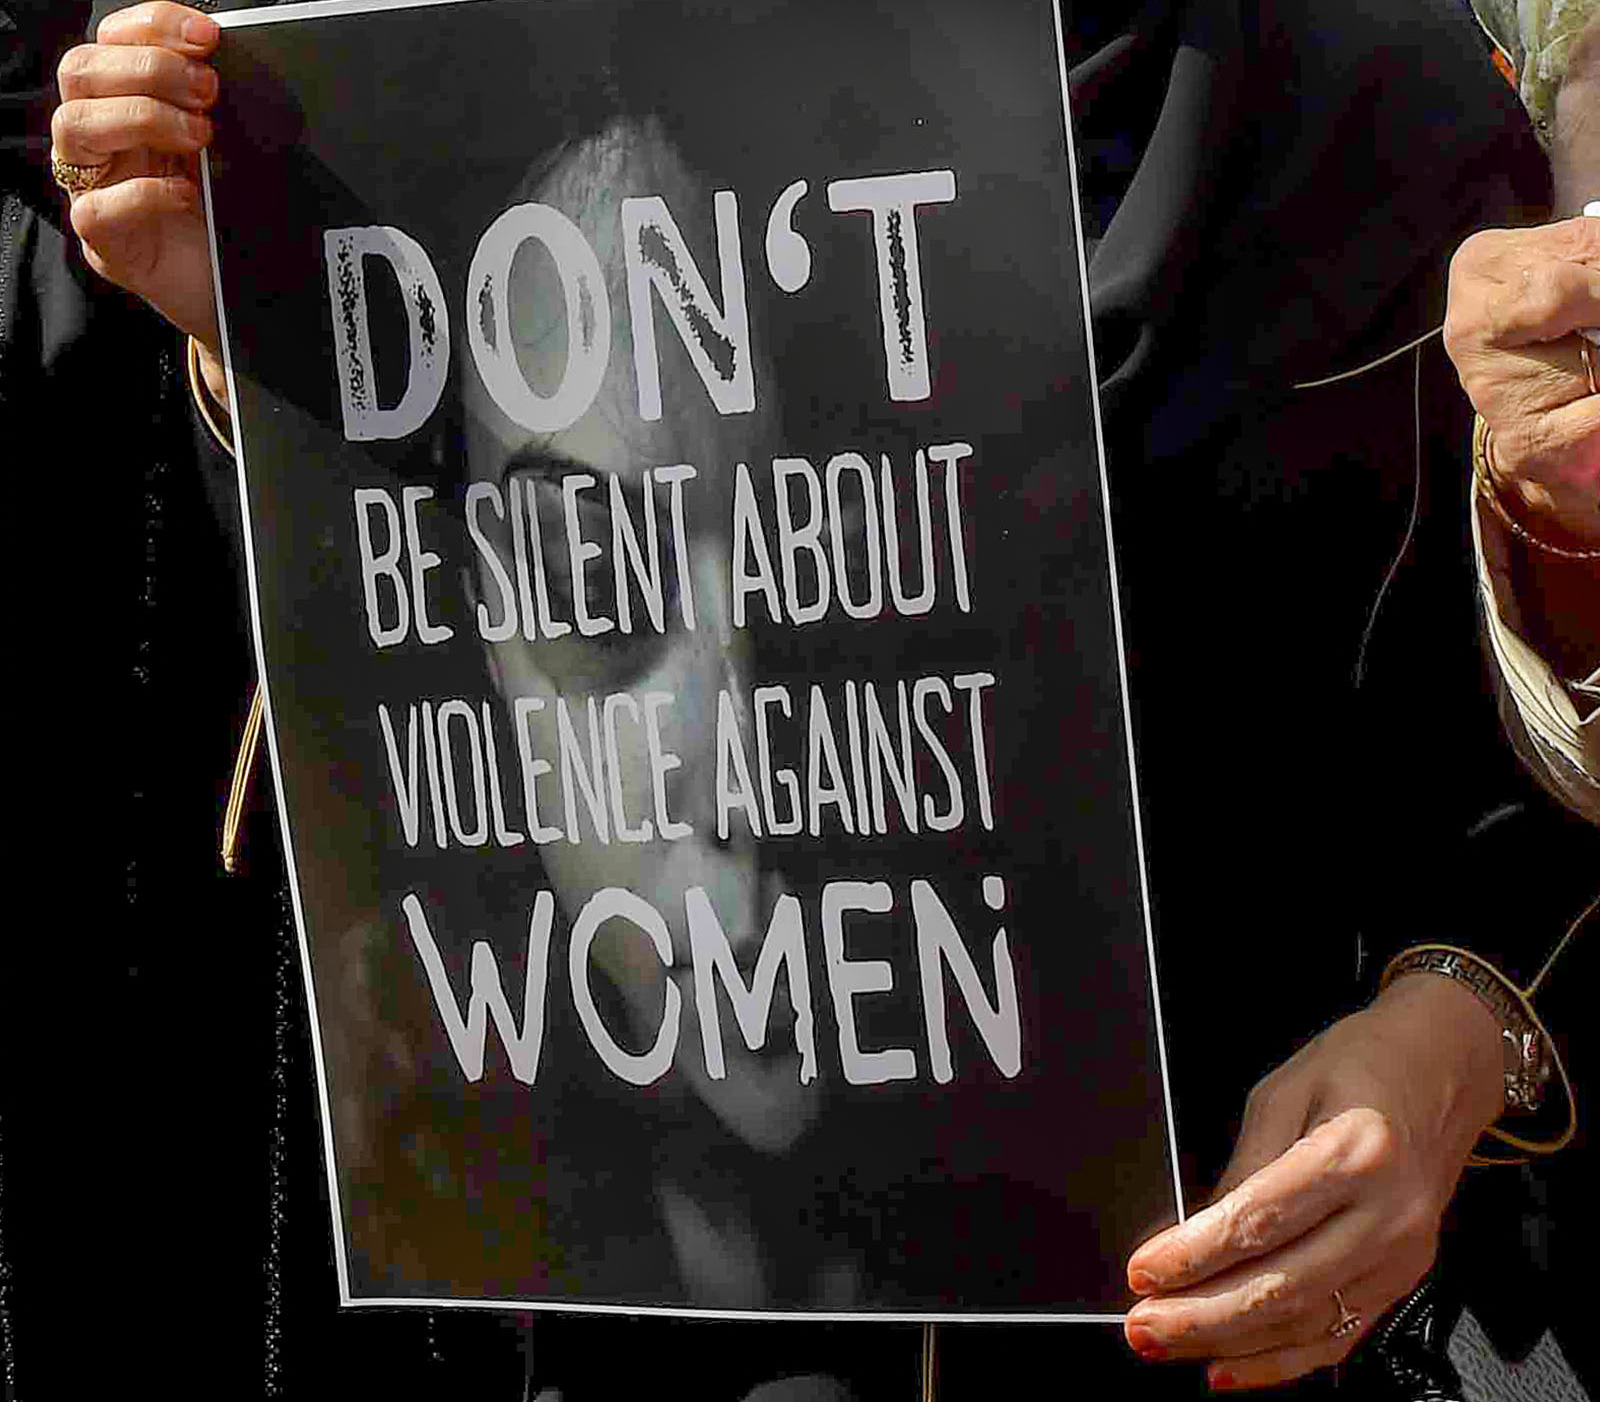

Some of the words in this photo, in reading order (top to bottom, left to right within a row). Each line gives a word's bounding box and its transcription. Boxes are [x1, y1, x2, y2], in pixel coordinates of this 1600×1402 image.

[354, 486, 455, 648] BE
[464, 464, 699, 644] SILENT
[732, 442, 974, 628] ABOUT
[377, 690, 691, 850] VIOLENCE
[716, 672, 995, 841] AGAINST
[402, 877, 1023, 1087] WOMEN
